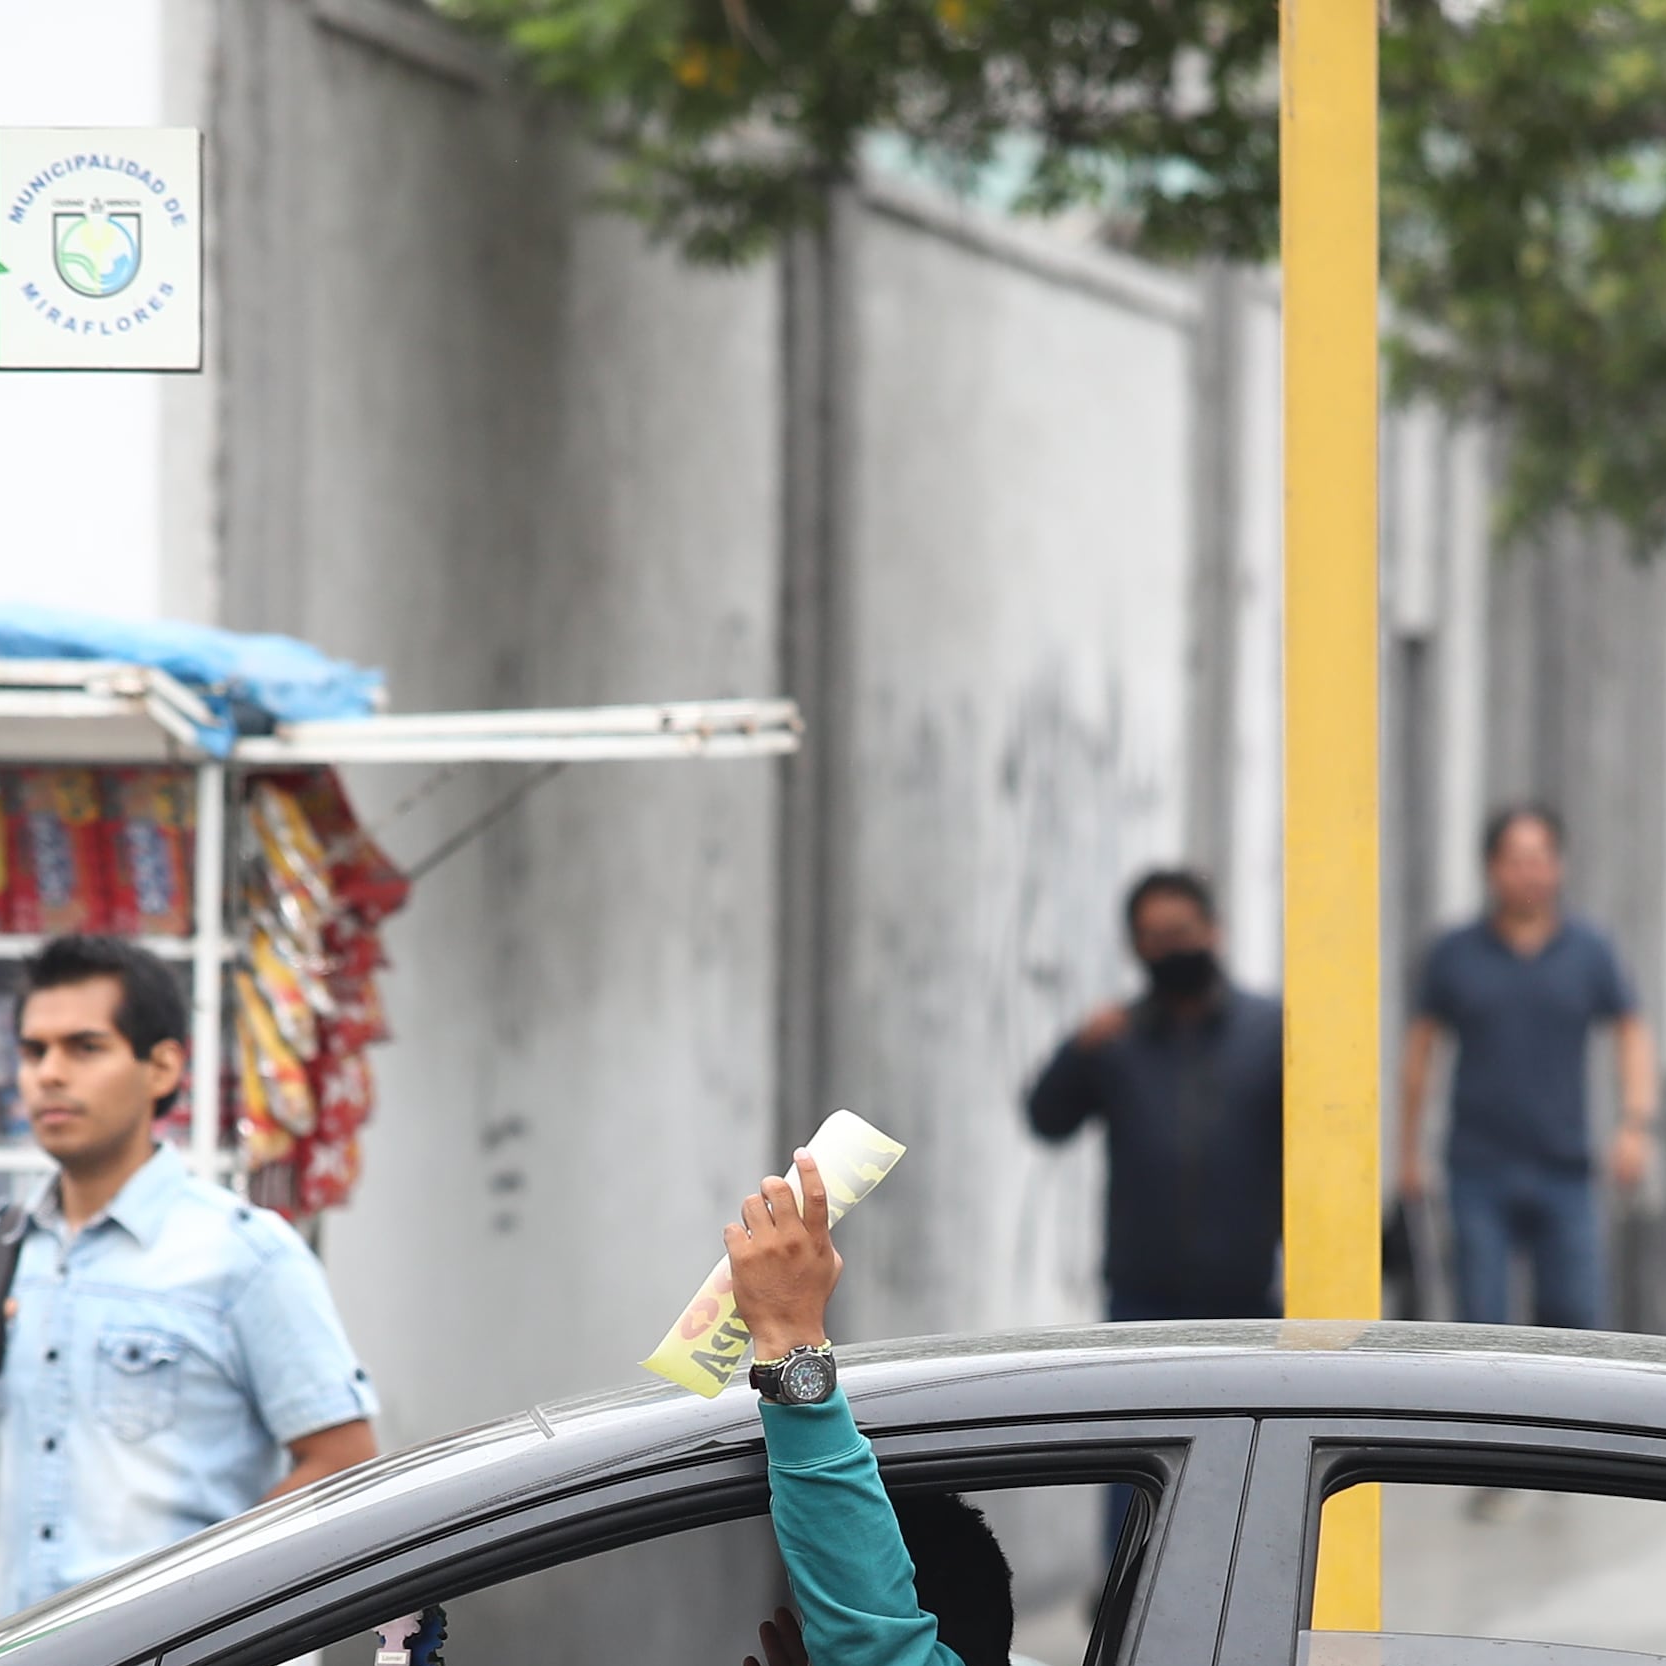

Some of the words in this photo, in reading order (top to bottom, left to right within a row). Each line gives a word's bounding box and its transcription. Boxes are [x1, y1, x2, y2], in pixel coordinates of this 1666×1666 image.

[8, 153, 166, 225] MUNICIPALIDAD
[163, 198, 187, 228] DE
[21, 281, 175, 336] MIRAFLORES
